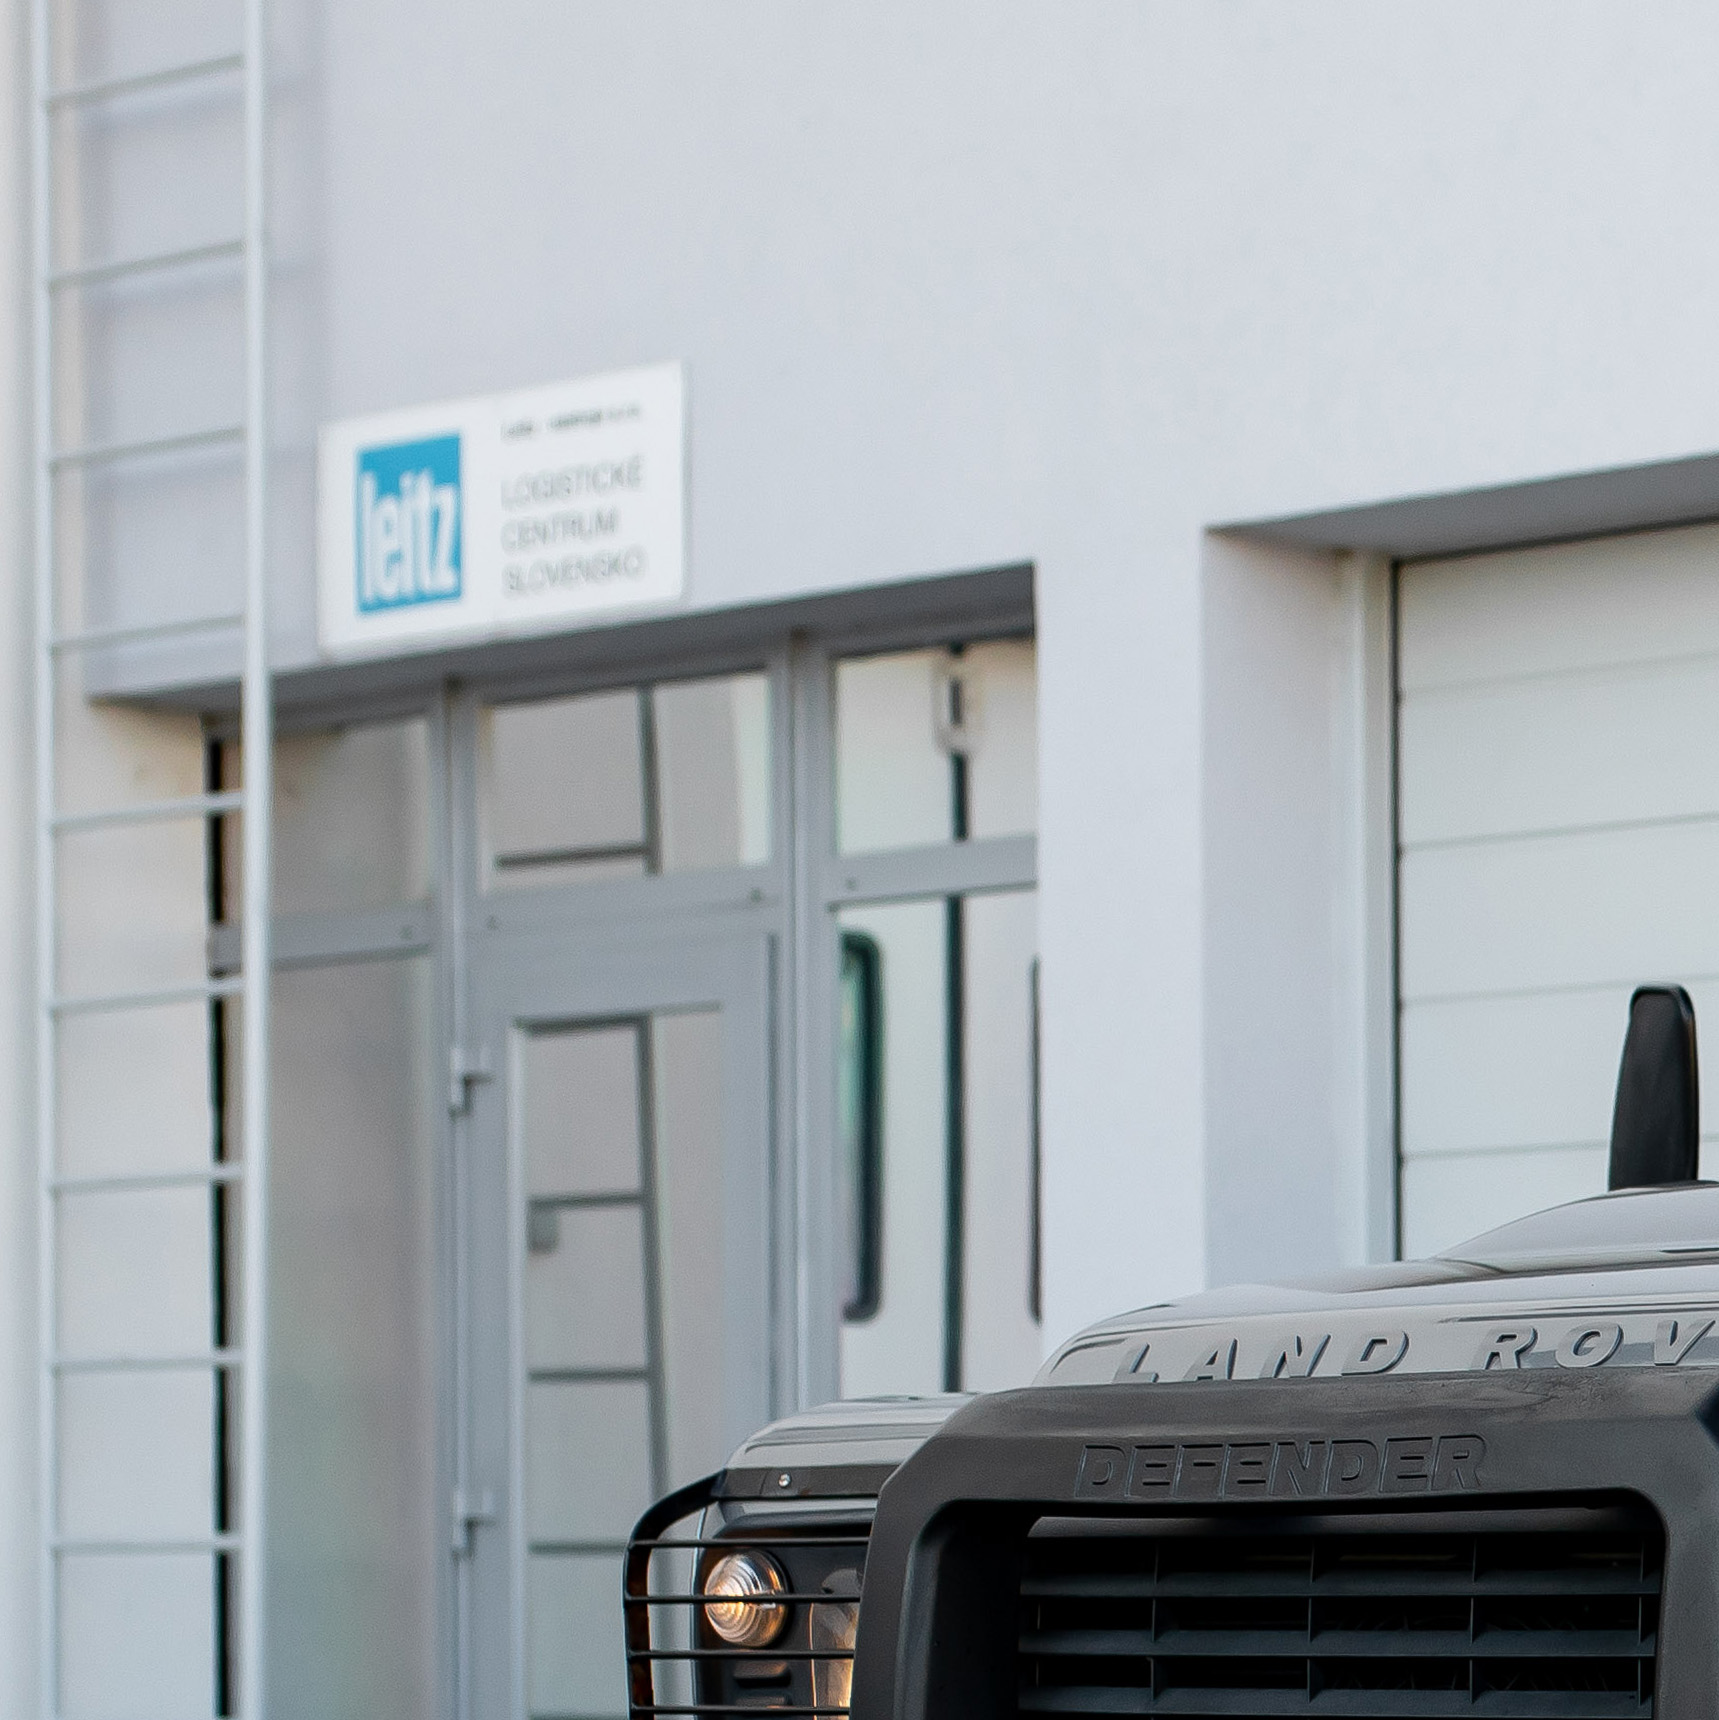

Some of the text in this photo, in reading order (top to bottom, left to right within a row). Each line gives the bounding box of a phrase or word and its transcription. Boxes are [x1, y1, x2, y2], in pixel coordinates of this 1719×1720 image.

[361, 466, 459, 601] leitz
[501, 506, 619, 551] CENTRUM
[501, 545, 648, 592] SLOVENSKO
[1113, 1329, 1409, 1384] LAND
[1075, 1435, 1488, 1497] DEFENDER
